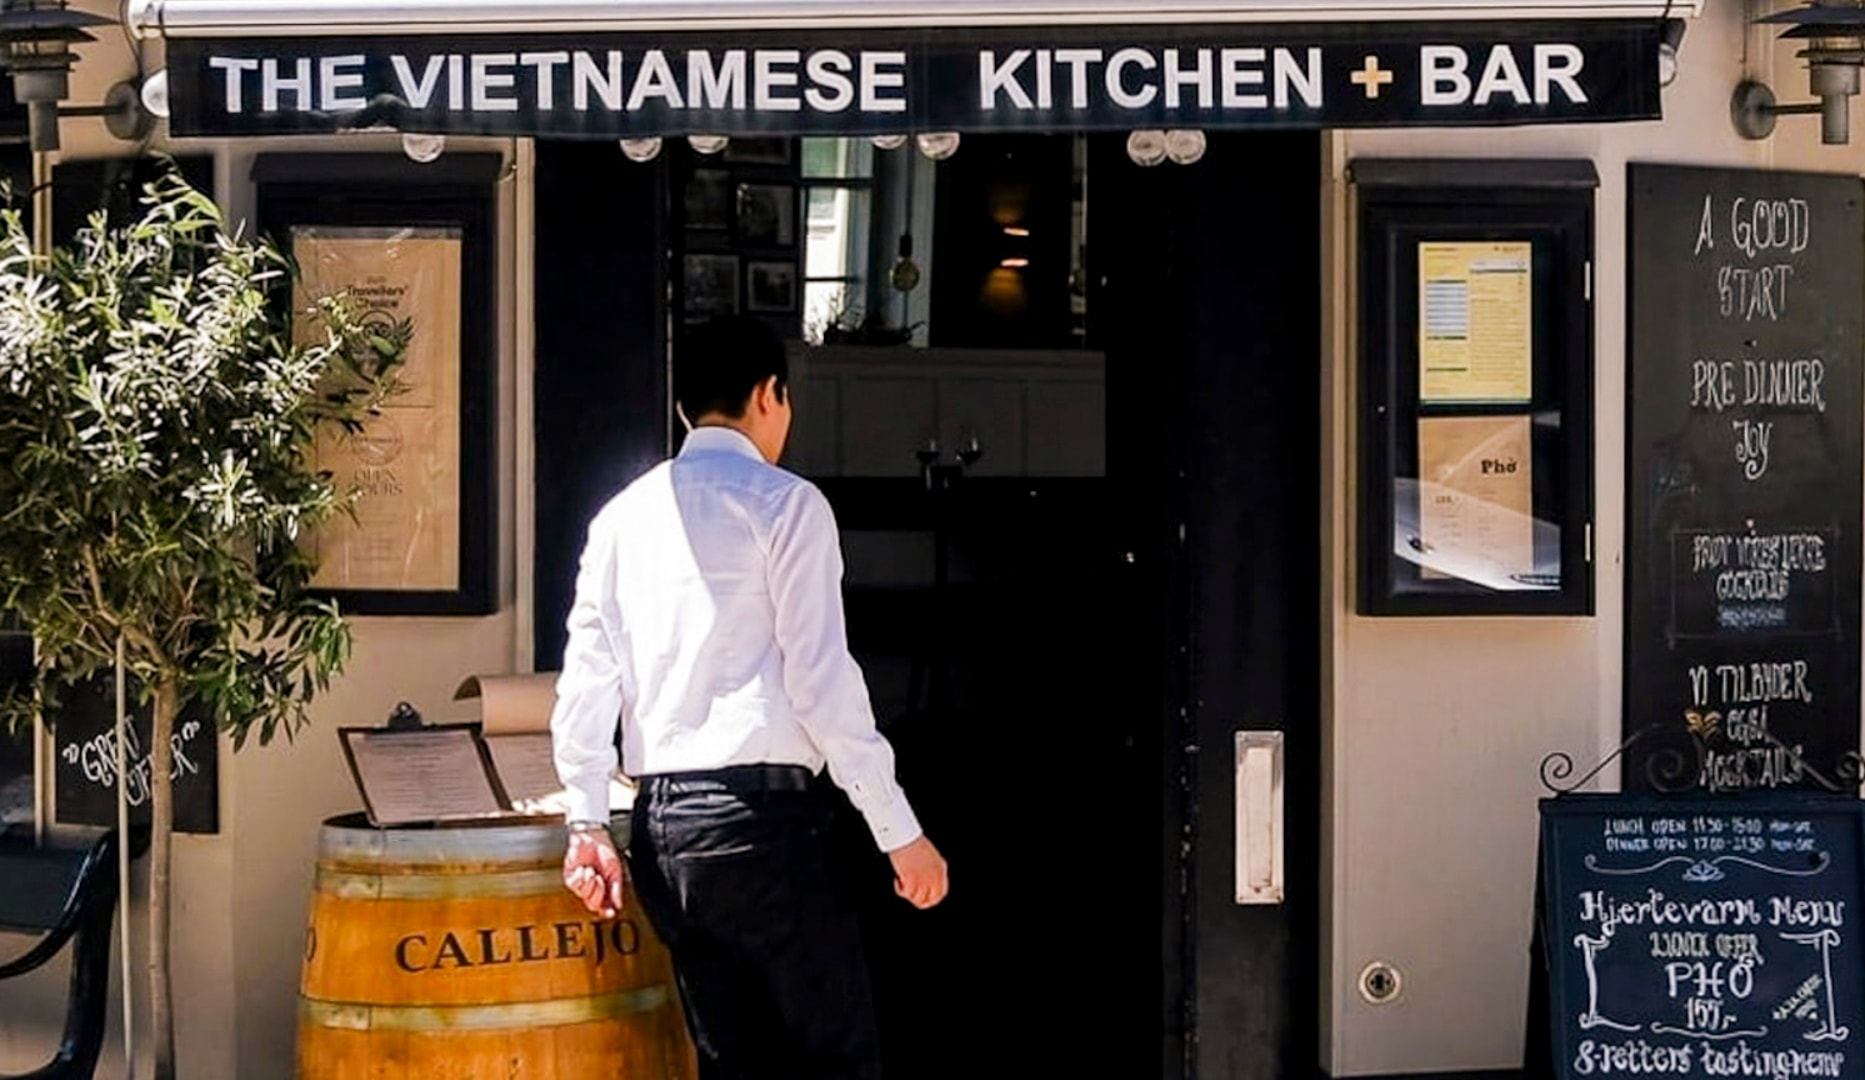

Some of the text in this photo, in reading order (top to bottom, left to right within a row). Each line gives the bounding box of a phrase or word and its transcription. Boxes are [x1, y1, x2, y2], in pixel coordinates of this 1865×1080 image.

[209, 44, 1588, 114] THE VIETNAMESE KITCHEN + BAR
[1694, 194, 1809, 258] A GOOD
[1718, 264, 1794, 321] START
[1691, 359, 1826, 412] PRE DINNER
[1732, 419, 1773, 480] JOY
[1769, 895, 1845, 927] Menu
[395, 918, 640, 973] CALLEJO
